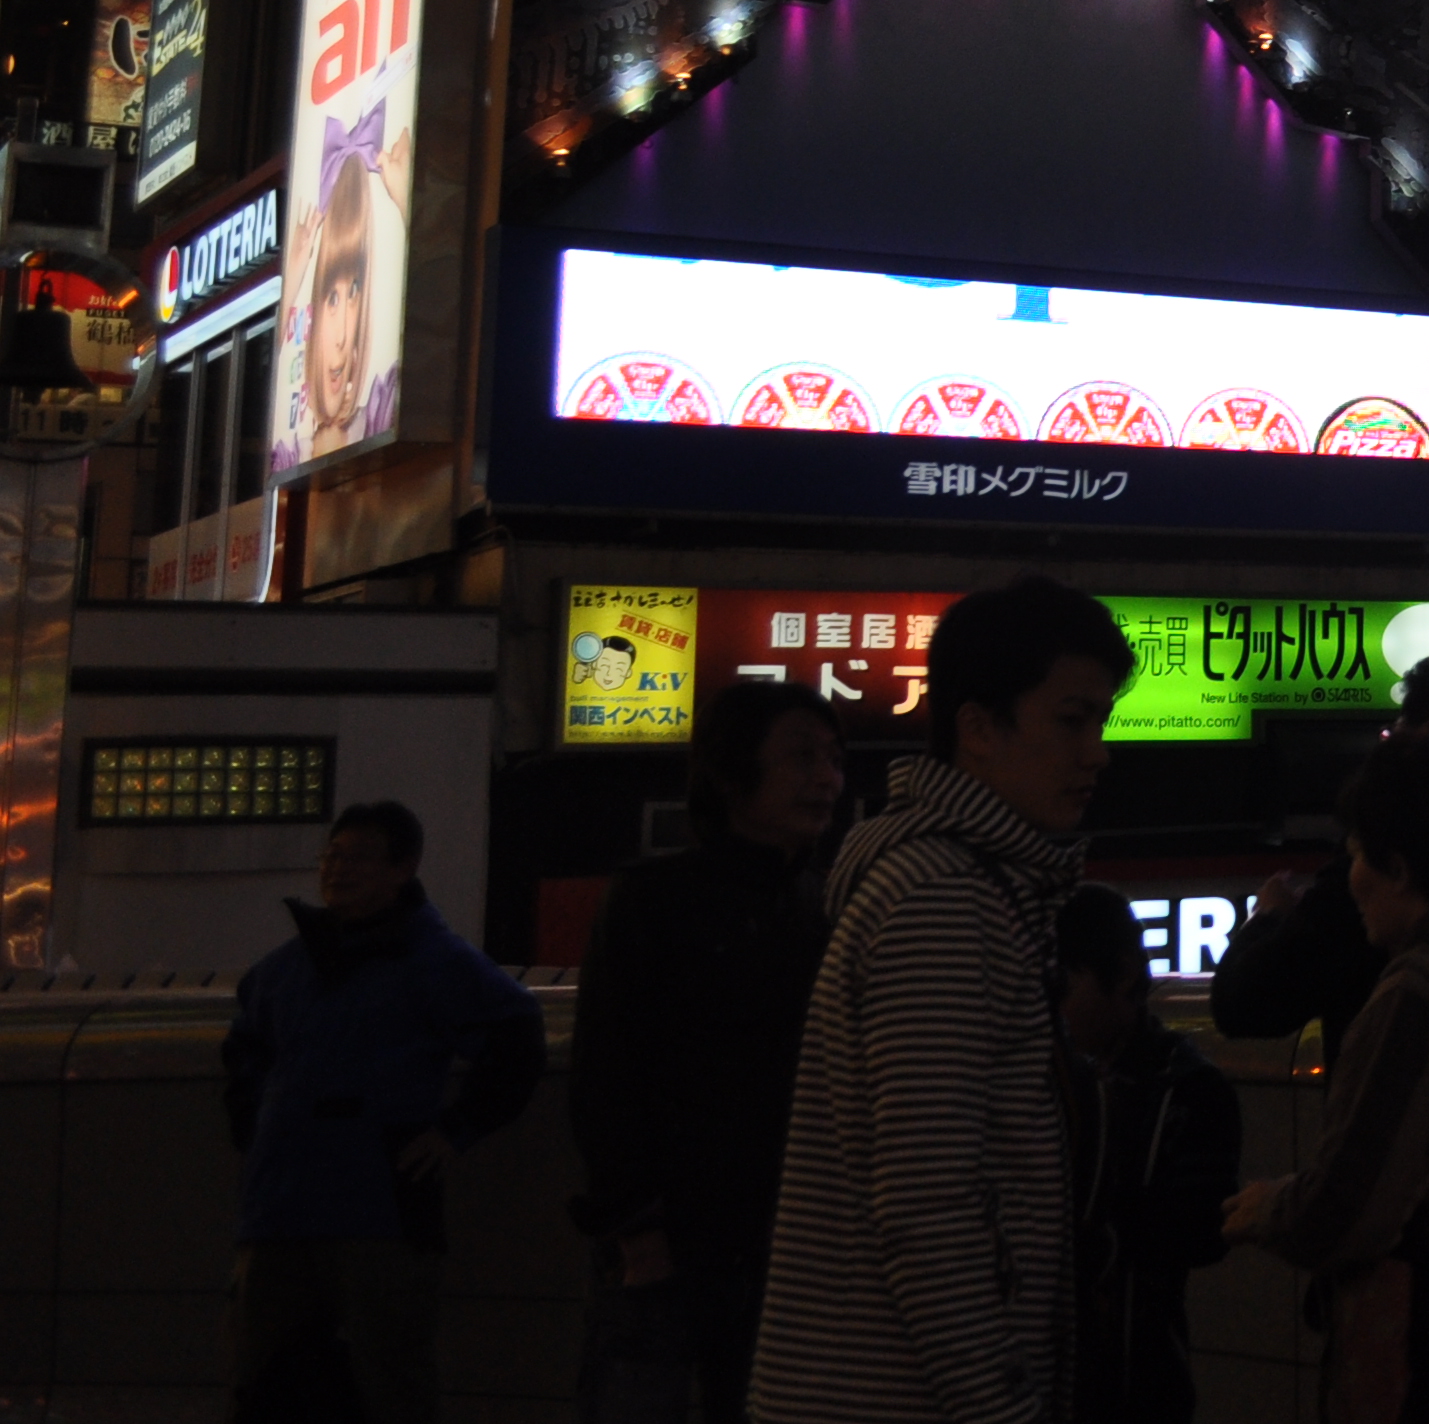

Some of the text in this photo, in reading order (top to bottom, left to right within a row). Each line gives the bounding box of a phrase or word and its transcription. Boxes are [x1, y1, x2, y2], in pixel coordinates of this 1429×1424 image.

[181, 189, 277, 301] LOTTERIA
[1330, 430, 1419, 459] Pizza
[902, 461, 1129, 502] 雪印メグミルク
[1202, 601, 1371, 682] ピタットハウス
[570, 705, 689, 726] 関西インベスト
[1201, 693, 1225, 704] New
[1228, 691, 1249, 704] Life
[1251, 691, 1289, 704] Station
[1294, 692, 1308, 707] by
